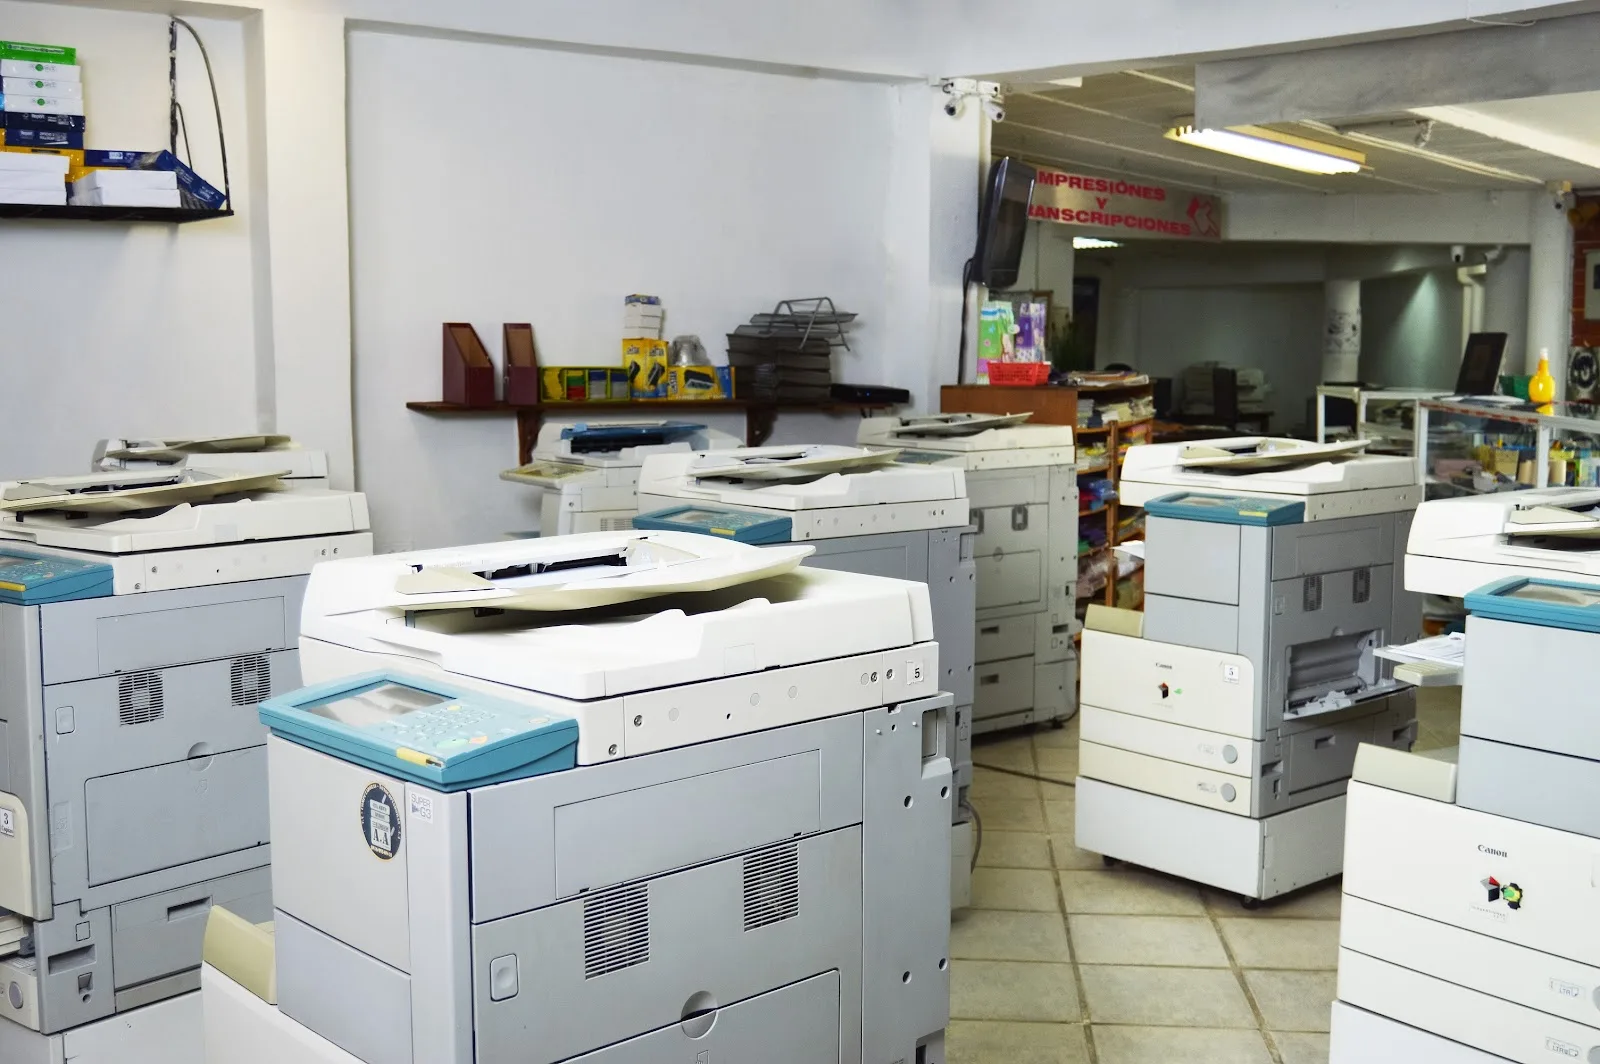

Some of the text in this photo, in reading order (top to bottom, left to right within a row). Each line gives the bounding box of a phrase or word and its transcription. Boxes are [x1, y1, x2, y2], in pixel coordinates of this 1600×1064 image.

[1096, 197, 1107, 210] Y
[914, 667, 920, 679] 5
[410, 793, 431, 808] SUPER
[4, 812, 9, 824] 3
[1477, 844, 1508, 858] Canon
